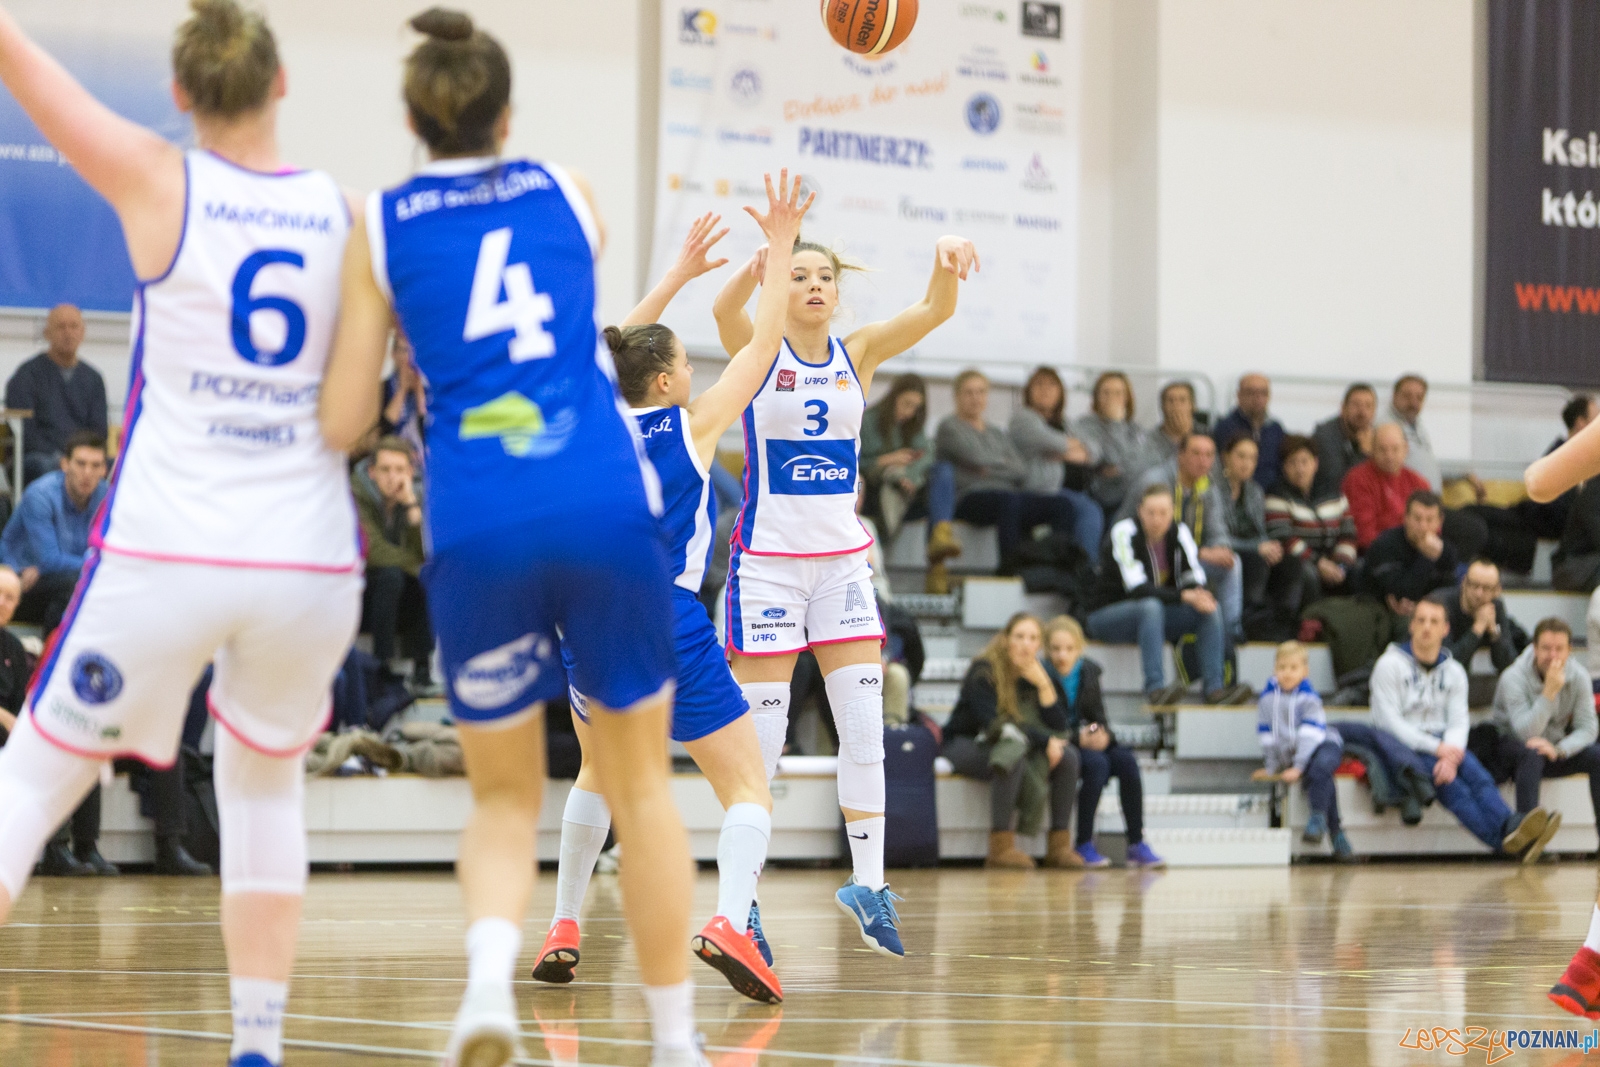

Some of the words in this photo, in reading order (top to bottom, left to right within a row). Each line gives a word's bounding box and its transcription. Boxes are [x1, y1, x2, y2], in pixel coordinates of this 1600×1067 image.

[231, 248, 307, 367] 6
[463, 226, 557, 364] 4
[803, 399, 829, 436] 3
[792, 464, 849, 481] Enea
[840, 616, 875, 626] AVENIDA
